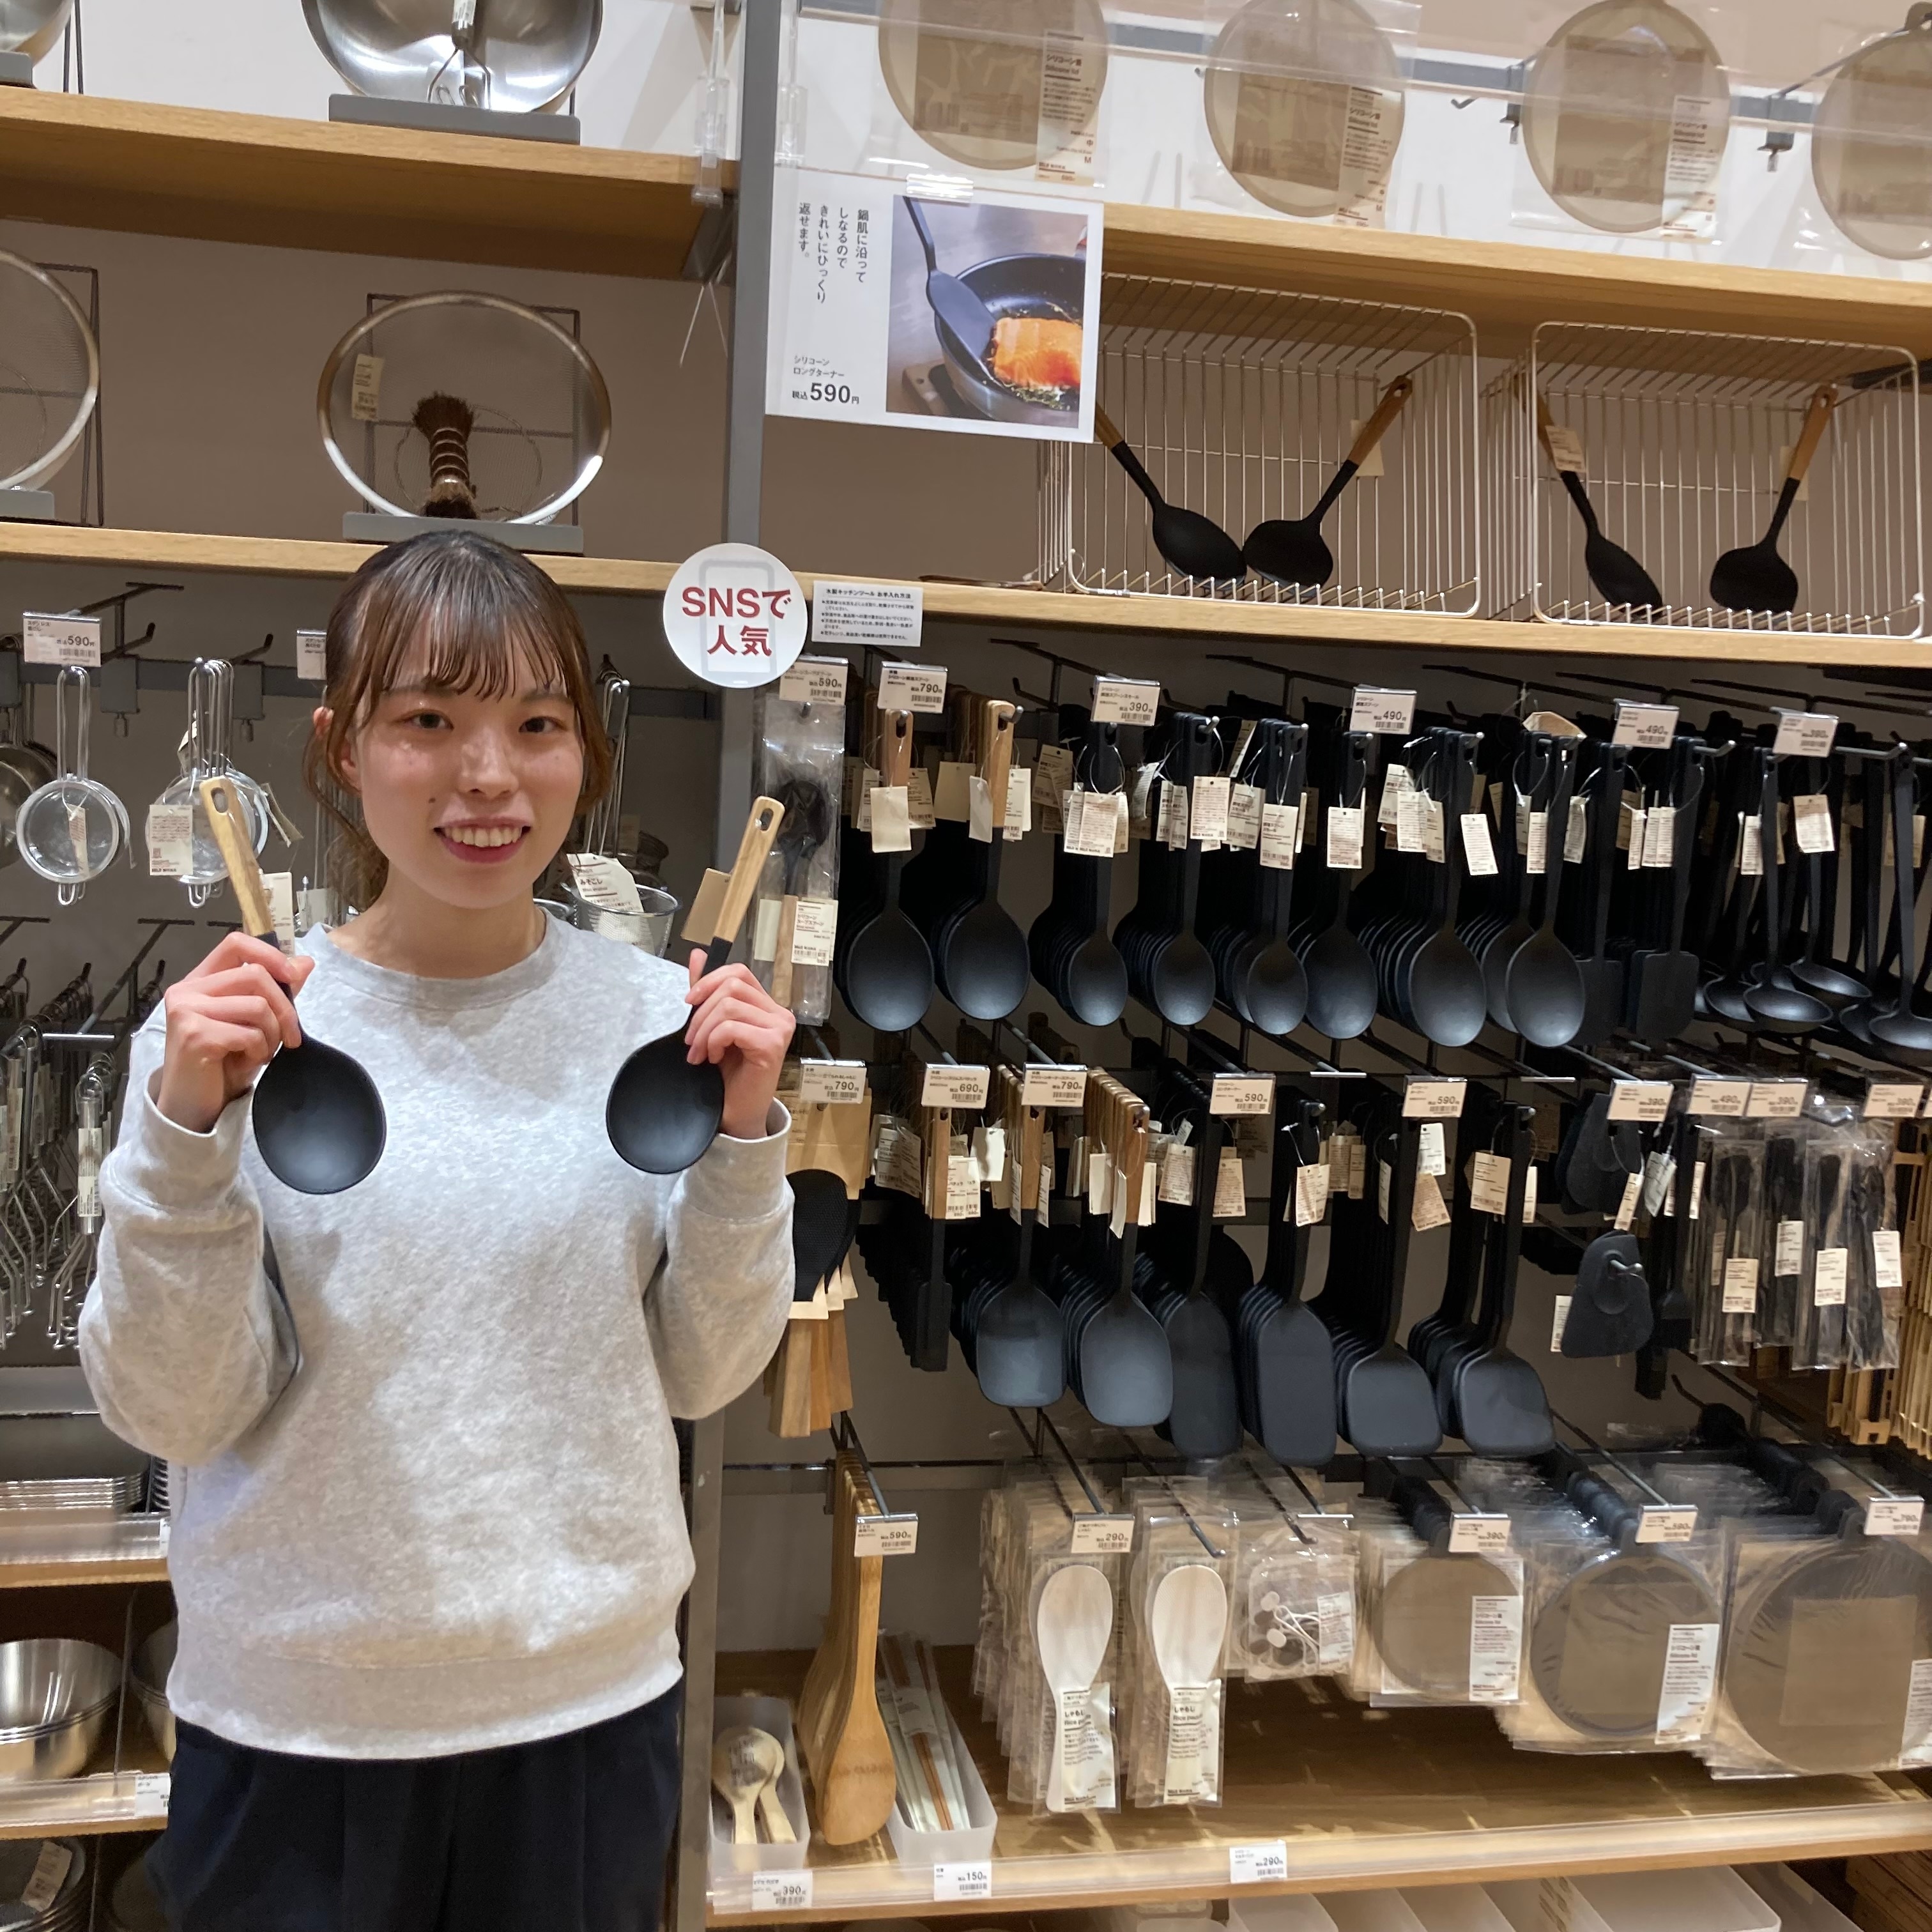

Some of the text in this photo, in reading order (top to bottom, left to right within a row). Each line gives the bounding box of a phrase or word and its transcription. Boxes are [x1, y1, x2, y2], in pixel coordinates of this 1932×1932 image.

[799, 203, 811, 257] 返せます。
[837, 207, 848, 268] しなるので
[855, 209, 869, 283] 鍋肌に沿って
[817, 205, 829, 303] きれいにひっくり
[793, 367, 845, 379] ロングターナー
[794, 355, 830, 366] シリコーン
[682, 586, 791, 619] SNSで
[707, 624, 772, 657] 人気
